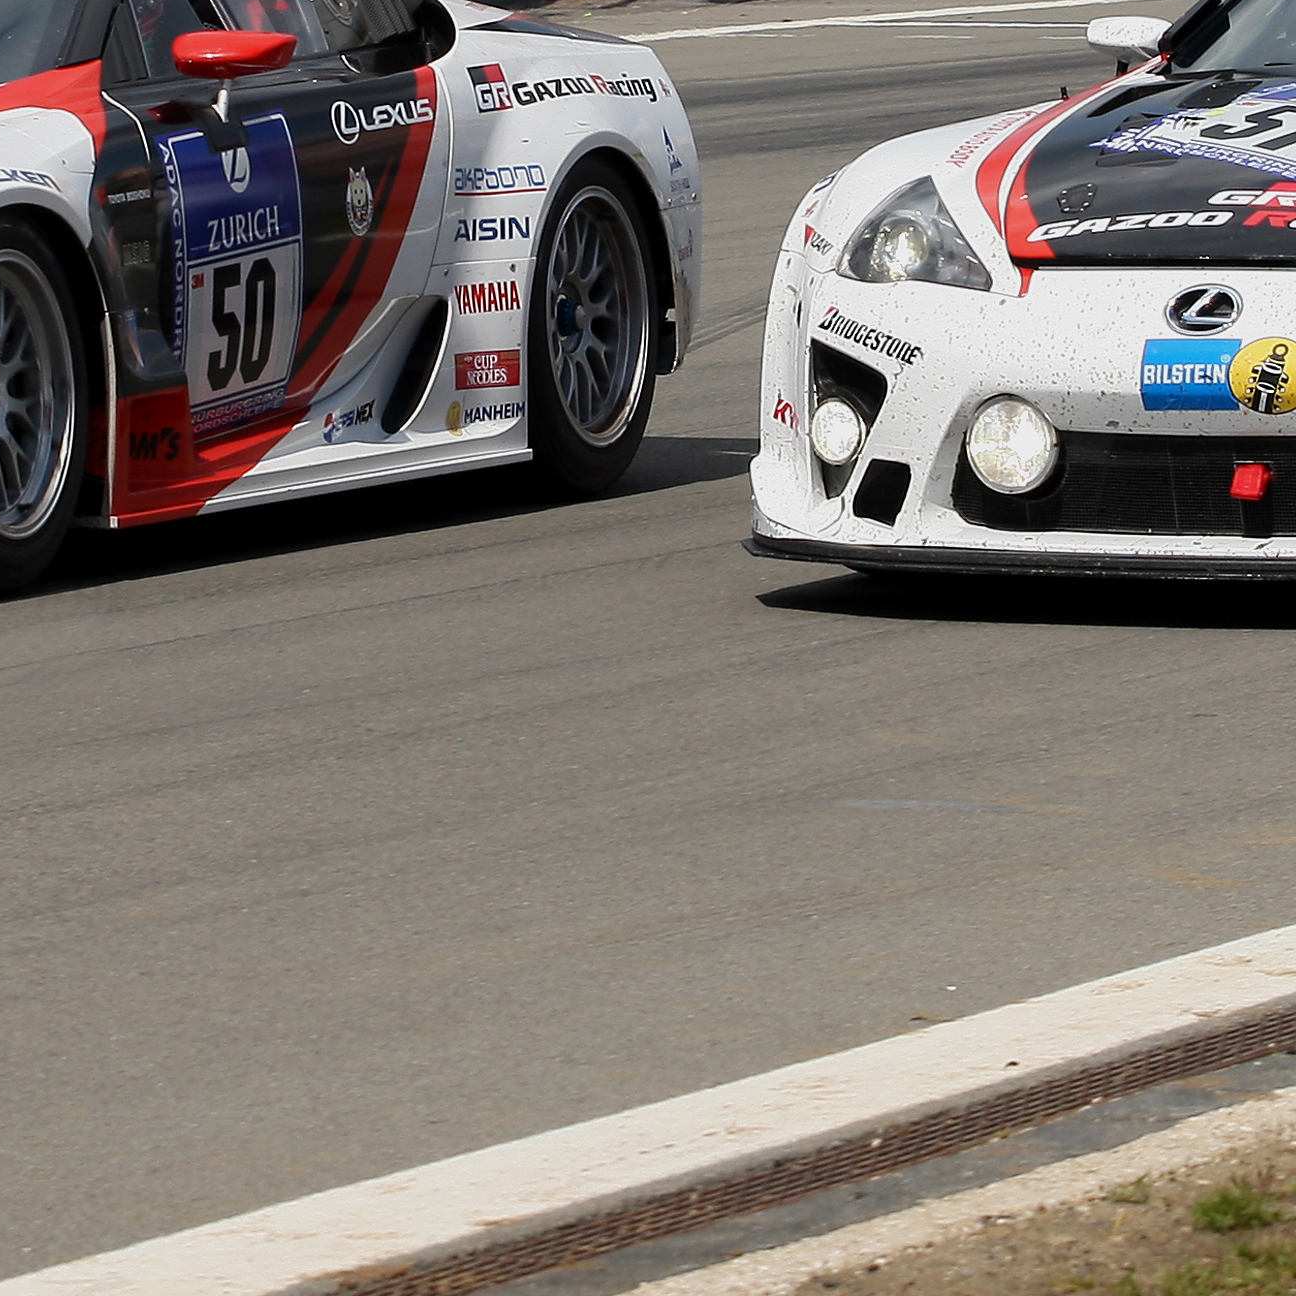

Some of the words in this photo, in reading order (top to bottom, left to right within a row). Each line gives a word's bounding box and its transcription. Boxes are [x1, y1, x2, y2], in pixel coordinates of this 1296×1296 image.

[476, 83, 512, 111] GR
[513, 75, 595, 106] GAZOO
[590, 73, 657, 104] Racing
[359, 99, 434, 132] LEXUS
[158, 142, 182, 228] ADAC
[454, 164, 546, 192] akebono
[207, 205, 281, 252] ZURICH
[454, 216, 530, 242] AISIN
[1026, 210, 1235, 243] GAZOO
[455, 280, 521, 315] YAMAHA
[207, 257, 277, 391] 50
[818, 307, 922, 365] BRIDGESTONE
[474, 354, 498, 369] CUP
[1144, 363, 1227, 385] BILSTEIN
[464, 401, 526, 424] MANHEIM
